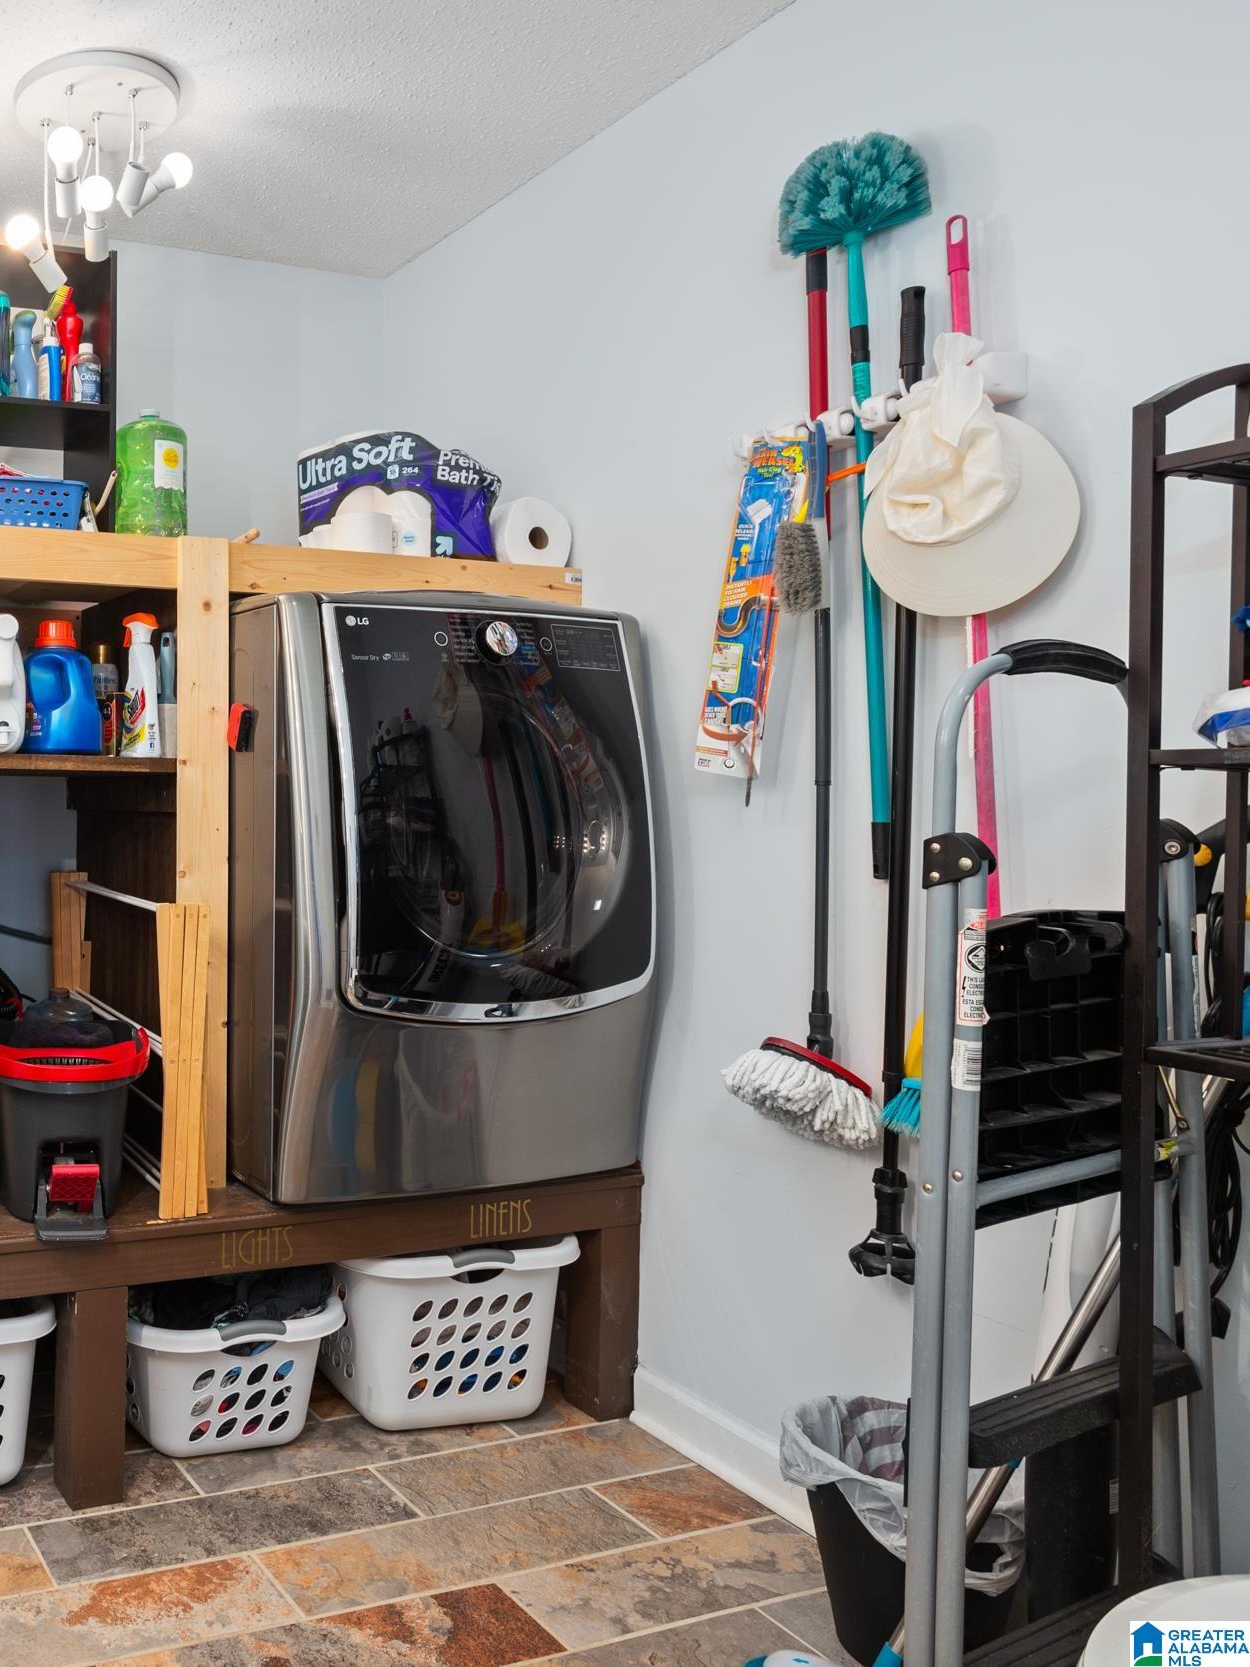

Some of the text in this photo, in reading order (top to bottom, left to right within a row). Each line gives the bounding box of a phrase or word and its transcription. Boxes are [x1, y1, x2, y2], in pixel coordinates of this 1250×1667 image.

[298, 435, 417, 490] Ultra Soft
[402, 466, 419, 475] 264
[753, 457, 797, 468] WEASEL
[437, 465, 480, 486] Bath
[357, 617, 370, 626] LG
[370, 654, 380, 662] Dry
[470, 1199, 533, 1239] LINENS
[221, 1225, 294, 1269] LIGHTS
